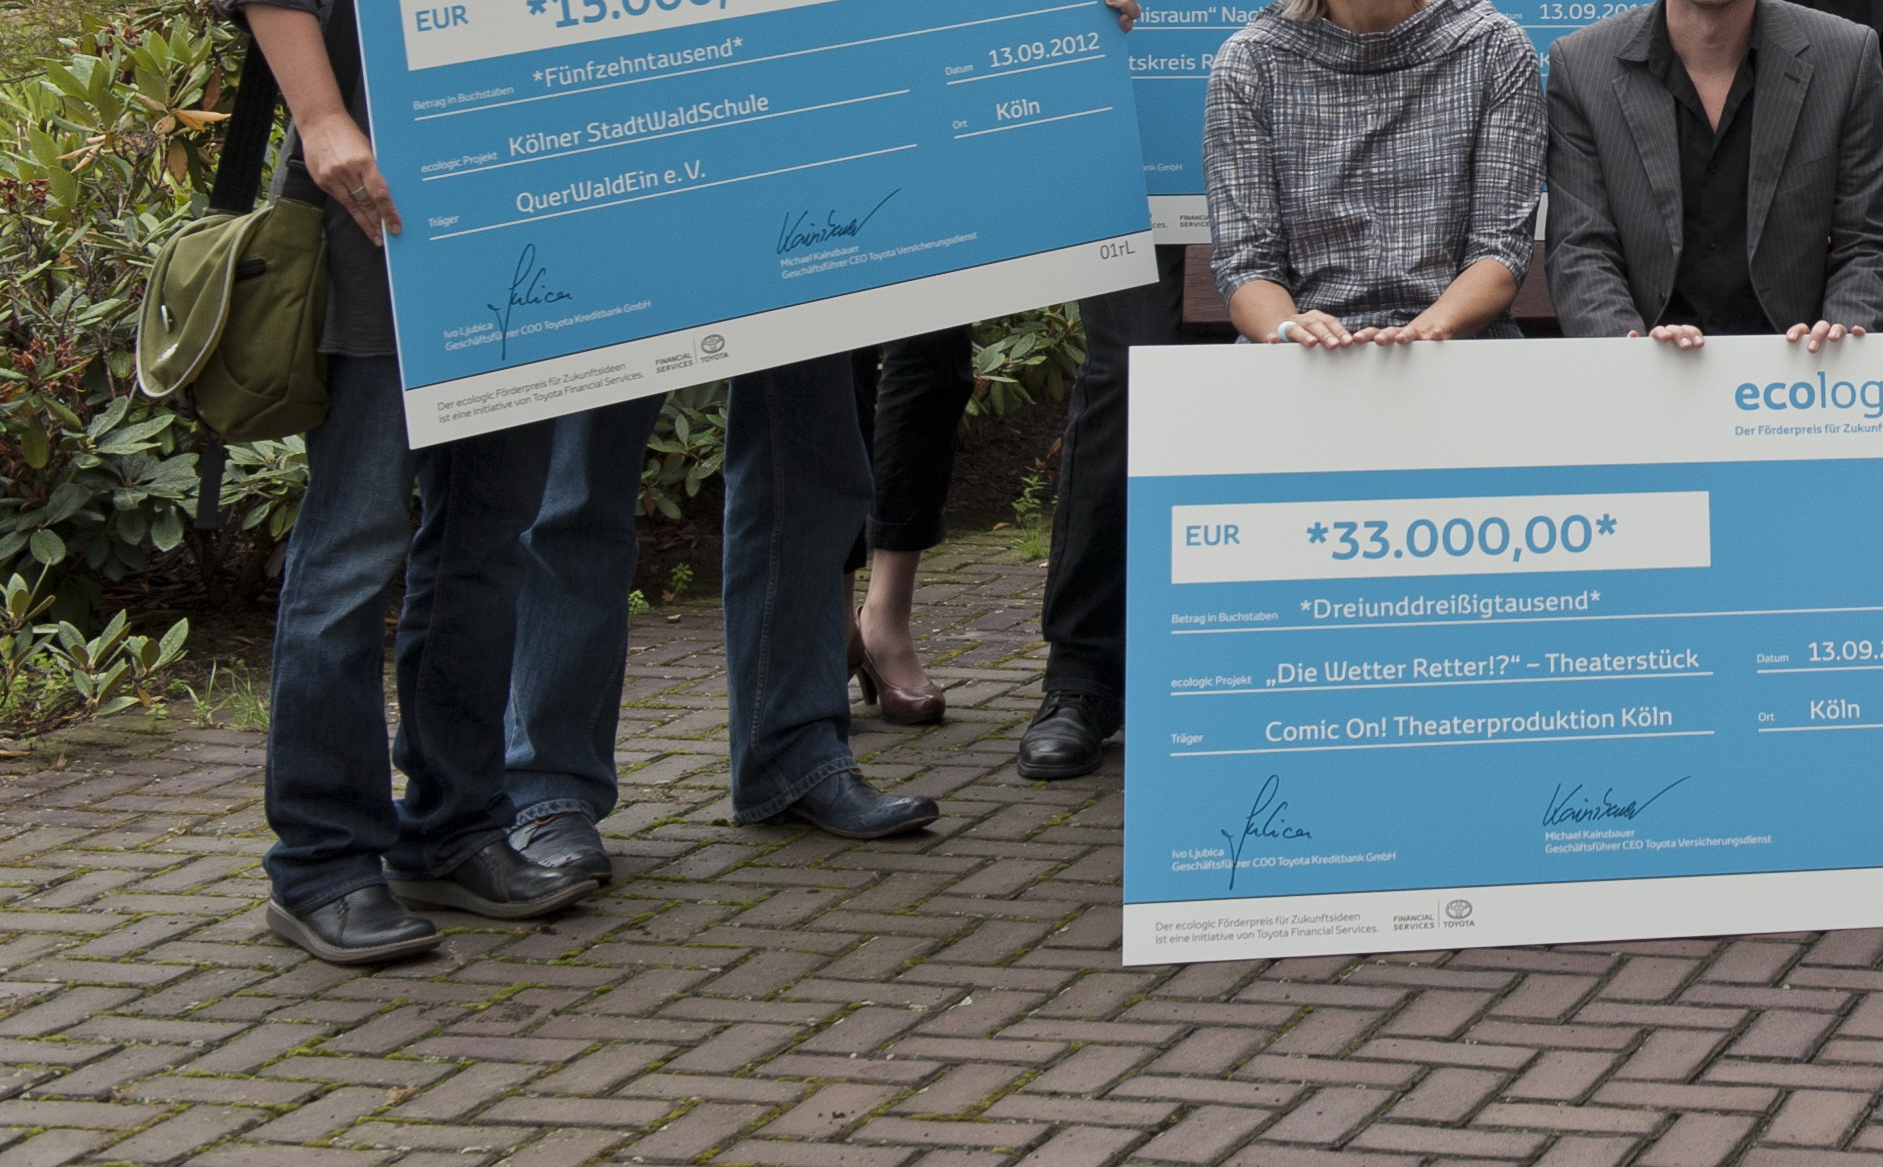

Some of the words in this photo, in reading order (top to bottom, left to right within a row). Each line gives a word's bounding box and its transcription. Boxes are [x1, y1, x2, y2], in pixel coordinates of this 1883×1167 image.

[414, 4, 469, 32] EUR
[1539, 3, 1645, 21] 13.09.20
[988, 31, 1100, 67] 13.09.2012
[1128, 54, 1196, 71] tskreis
[995, 98, 1040, 121] Köln
[508, 130, 582, 156] Kölner
[586, 93, 769, 142] StadtWaldSchule
[515, 169, 659, 213] QuerWaldEin
[663, 169, 682, 184] e.
[683, 159, 706, 180] V.
[1099, 239, 1135, 260] 01rL
[1734, 425, 1755, 436] Der
[1757, 423, 1822, 437] Förderpreis
[1823, 423, 1841, 434] für
[1185, 523, 1240, 546] EUR
[1170, 613, 1206, 625] Betrag
[1206, 612, 1217, 622] in
[1217, 610, 1278, 622] Buchstaben
[1755, 653, 1789, 663] Datum
[1170, 675, 1213, 689] ecologic
[1214, 674, 1252, 688] Projekt
[1265, 662, 1317, 687] „Die
[1323, 660, 1406, 681] Wetter
[1413, 654, 1520, 678] Retter!?“
[1544, 648, 1699, 673] Theaterstück
[1757, 711, 1775, 722] Ort
[1809, 698, 1860, 719] Köln
[1170, 732, 1204, 745] Träger
[1265, 718, 1339, 742] Comic
[1345, 716, 1386, 739] On!
[1392, 708, 1614, 738] Theaterproduktion
[1621, 705, 1672, 727] Köln
[1544, 830, 1581, 841] Michael
[1582, 828, 1635, 839] Kainzbauer
[1171, 848, 1187, 858] Ivo
[1188, 847, 1224, 860] Ljubica
[1621, 839, 1643, 850] CEO
[1644, 838, 1676, 851] Toyota
[1251, 856, 1276, 867] COO
[1277, 856, 1310, 868] Toyota
[1311, 853, 1364, 864] Kreditbank
[1365, 851, 1396, 861] GmbH
[1155, 921, 1173, 931] Der
[1174, 918, 1216, 931] ecologic
[1217, 916, 1273, 928] Förderpreis
[1274, 914, 1289, 925] für
[1290, 912, 1360, 924] Zukunftsideen
[1393, 913, 1433, 922] FINANCIAL
[1393, 921, 1434, 931] SERVICES
[1443, 917, 1475, 928] TOYOTA
[1155, 935, 1167, 944] ist
[1168, 933, 1190, 944] eine
[1191, 931, 1234, 942] Initiative
[1235, 931, 1255, 940] von
[1256, 928, 1289, 941] Toyota
[1290, 925, 1333, 936] Financial
[1334, 924, 1379, 935] Services.
